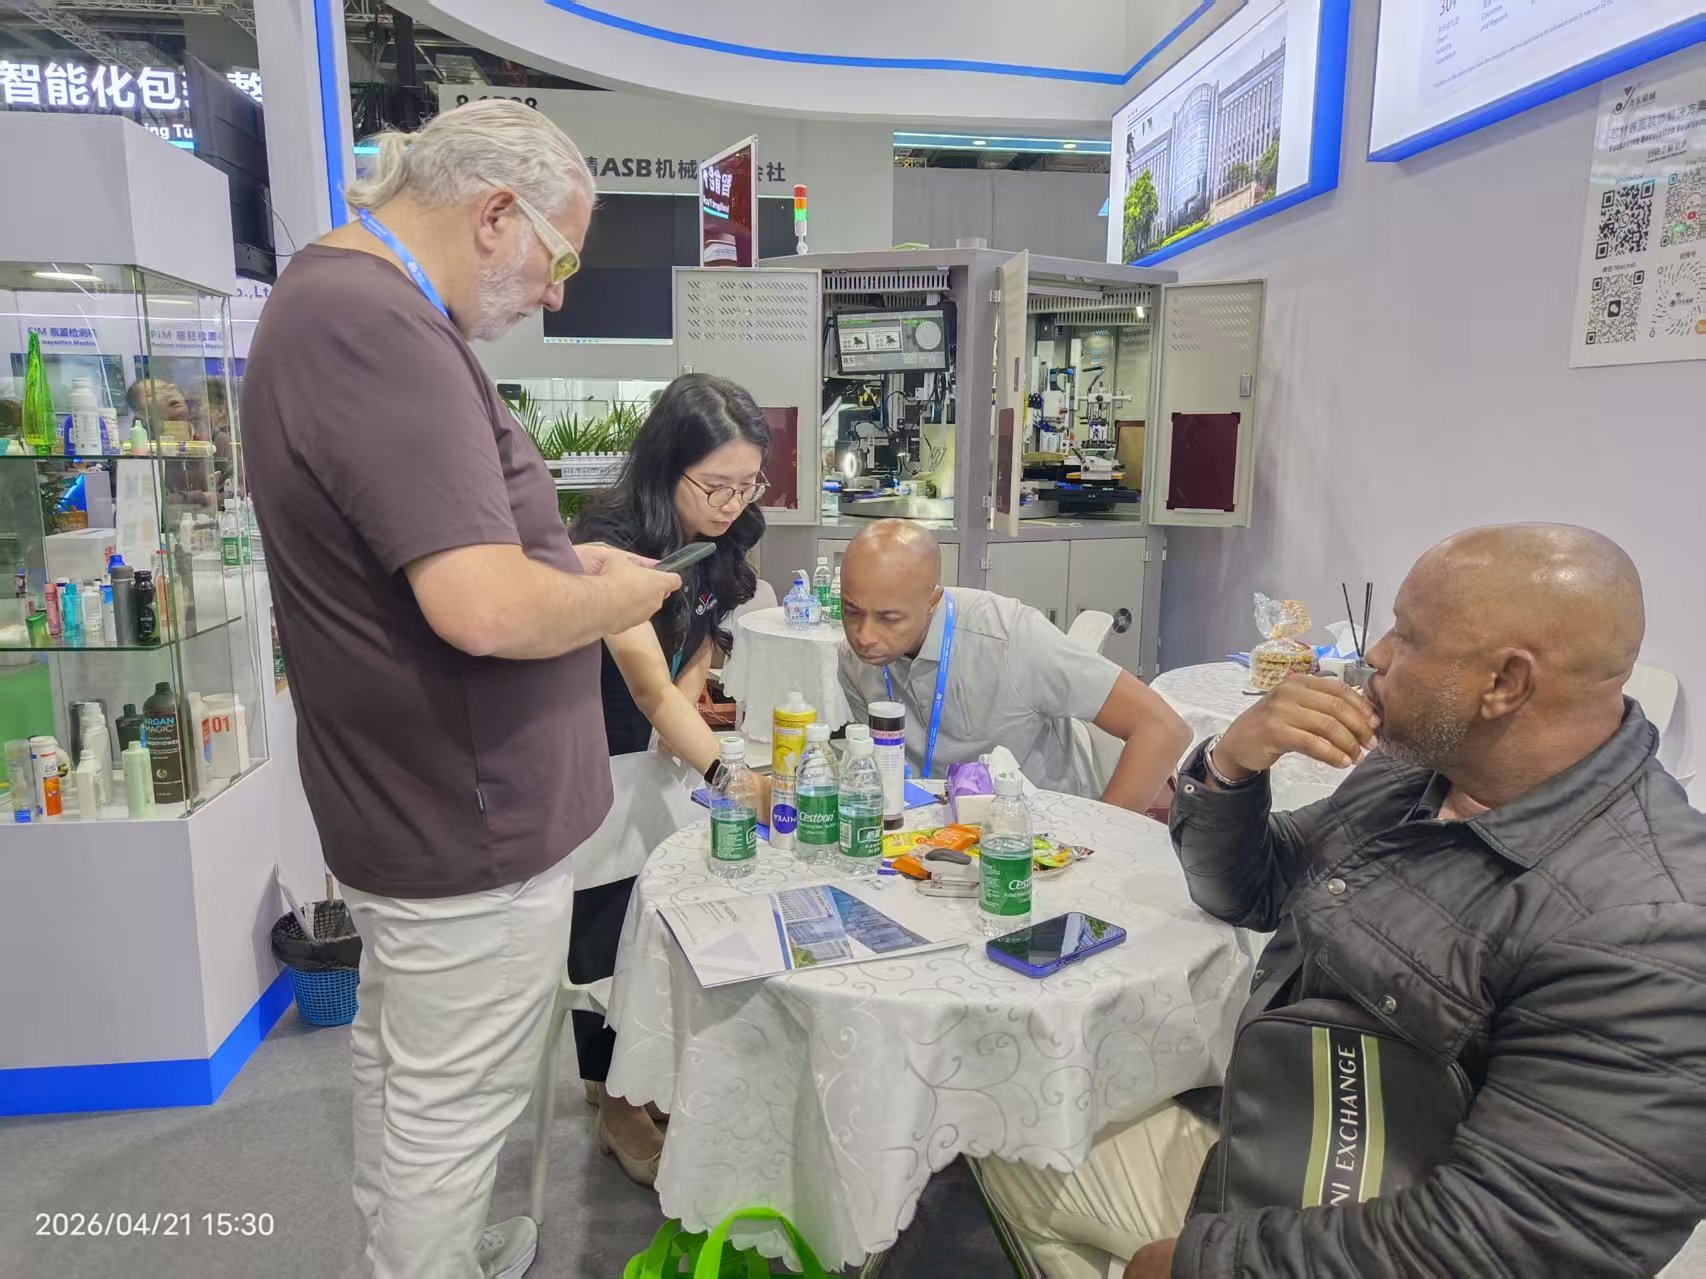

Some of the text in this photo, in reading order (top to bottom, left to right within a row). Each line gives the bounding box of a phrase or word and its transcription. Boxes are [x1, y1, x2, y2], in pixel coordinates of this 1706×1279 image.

[0, 60, 190, 110] 智能化包
[585, 155, 703, 181] ASB机械
[774, 814, 796, 823] NIVEA
[799, 811, 835, 823] Cestbon
[1335, 1044, 1358, 1172] EXCHANGE
